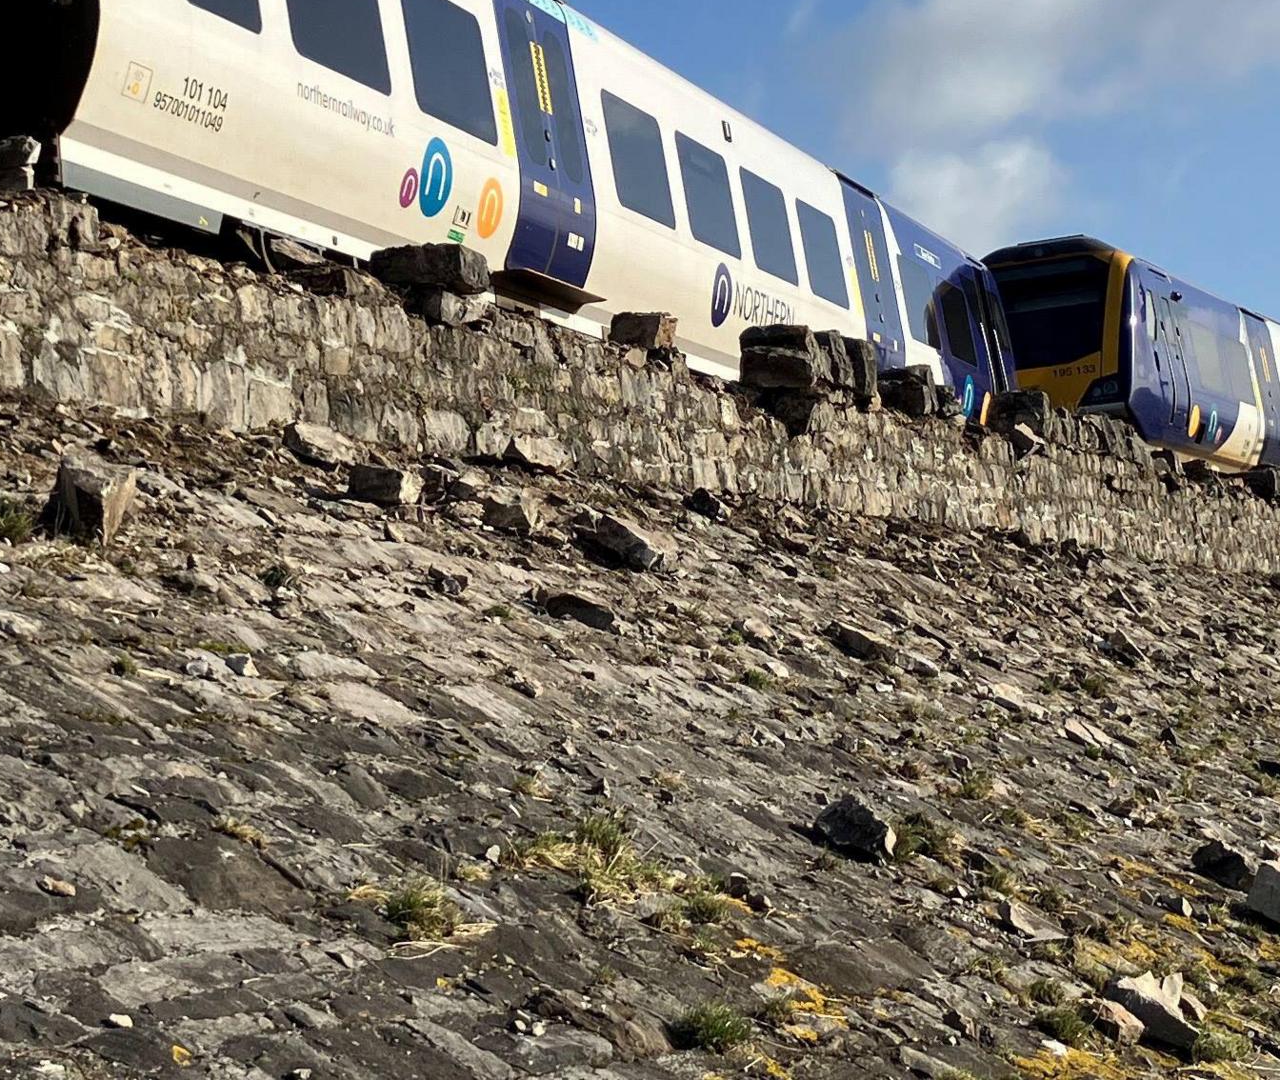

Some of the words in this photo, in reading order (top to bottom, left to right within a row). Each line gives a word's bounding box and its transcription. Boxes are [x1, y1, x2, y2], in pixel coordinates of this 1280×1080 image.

[152, 91, 224, 133] 957001011049
[182, 76, 204, 102] 101
[207, 86, 229, 112] 104
